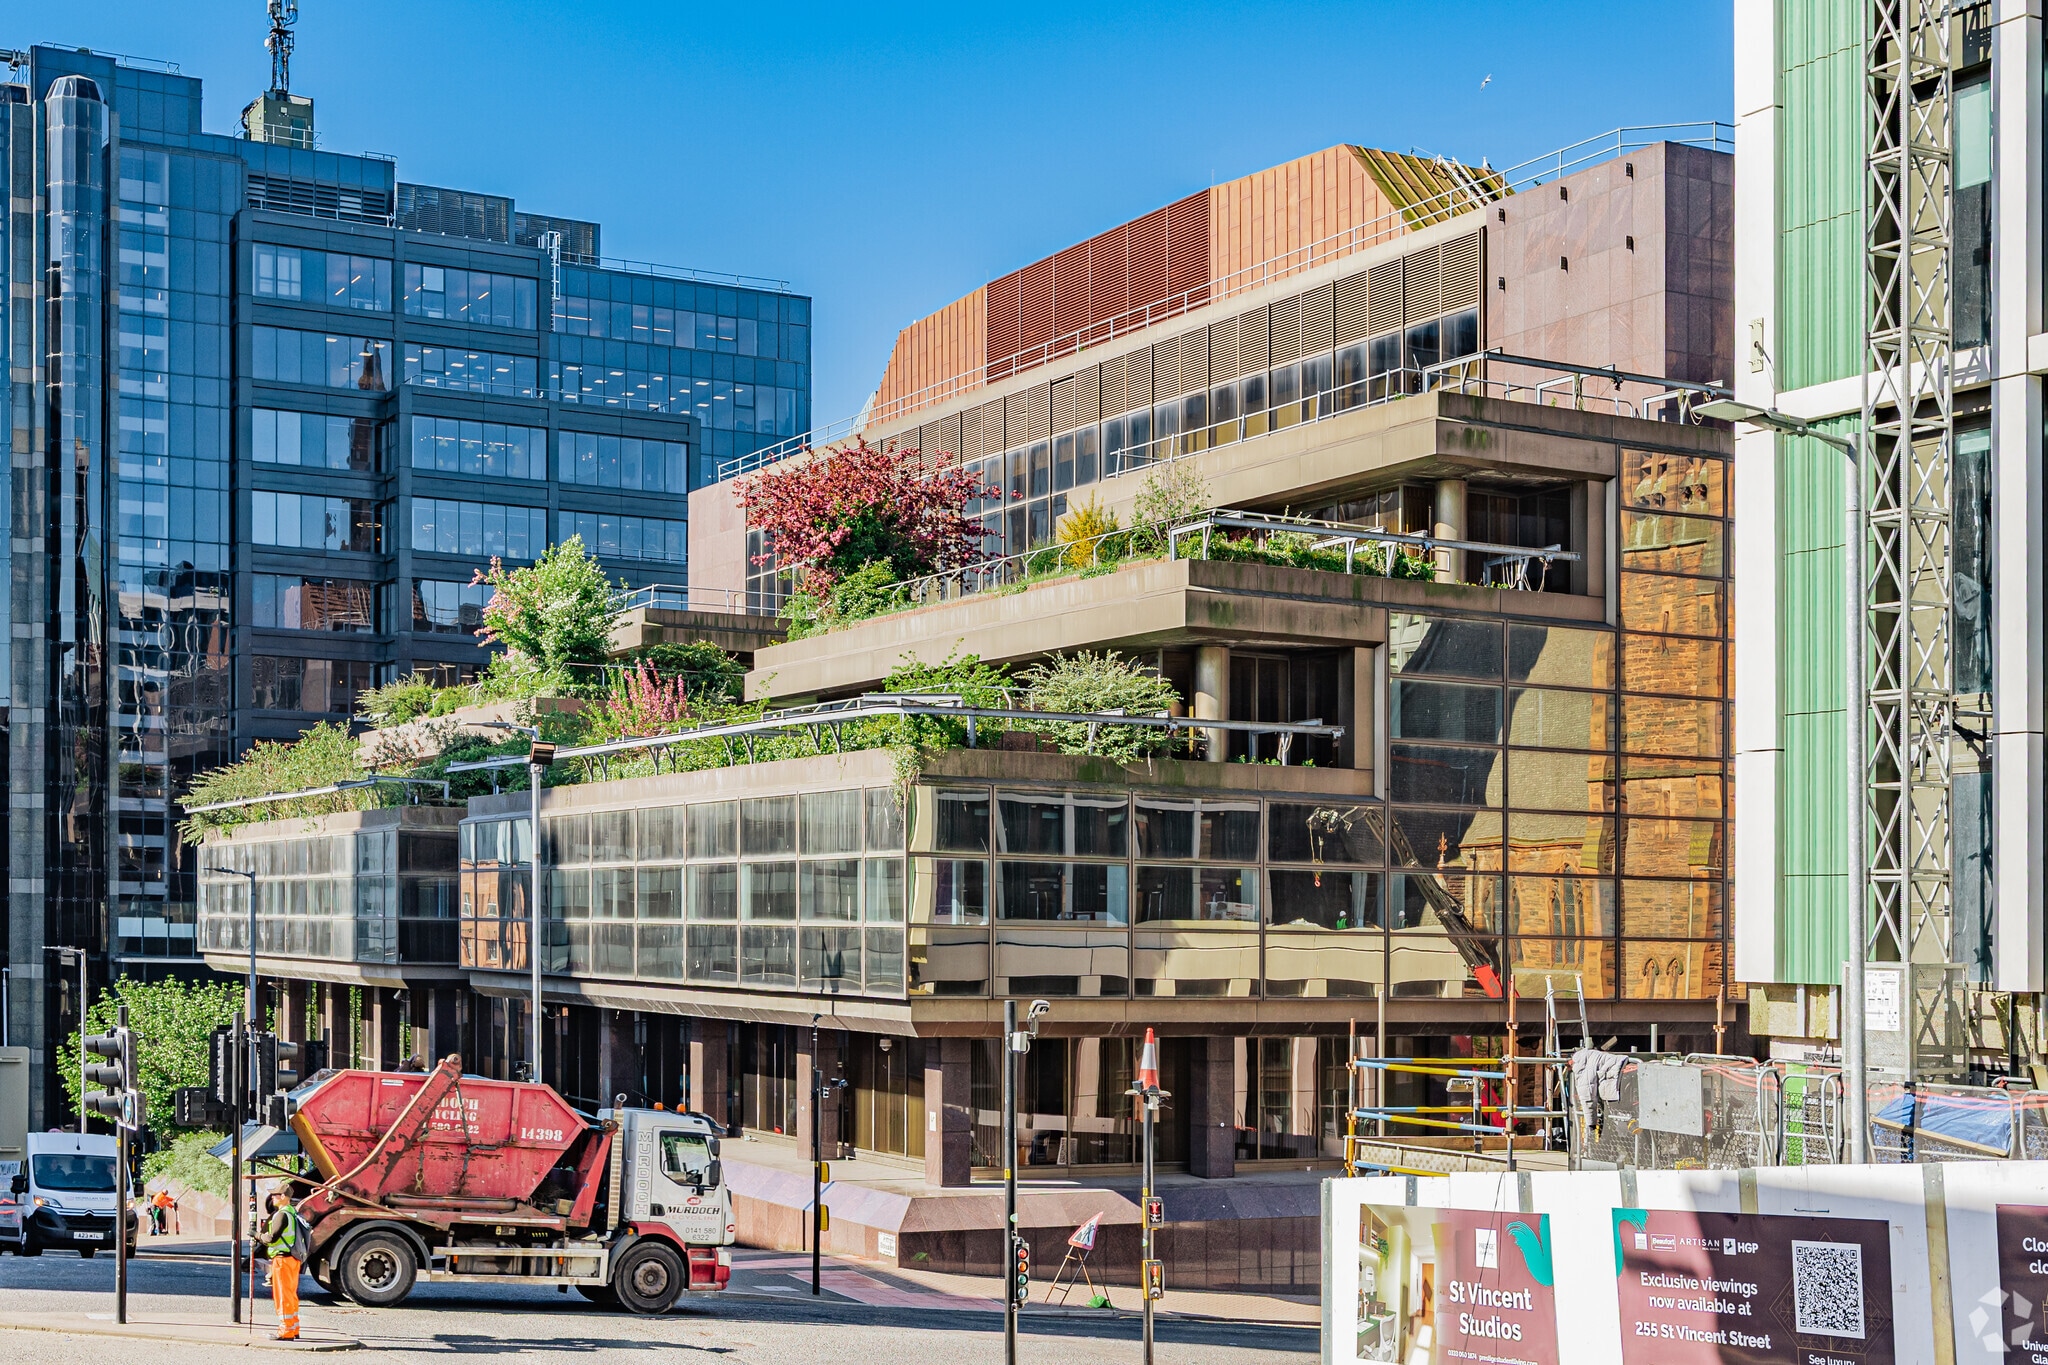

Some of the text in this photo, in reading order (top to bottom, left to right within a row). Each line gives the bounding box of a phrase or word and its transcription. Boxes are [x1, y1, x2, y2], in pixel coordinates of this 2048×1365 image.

[455, 1123, 480, 1134] 622
[520, 1127, 563, 1142] 14398
[635, 1131, 653, 1215] MURDOCH
[666, 1206, 720, 1215] MURDOCH
[704, 1227, 717, 1235] 580
[1679, 1237, 1720, 1247] ARTISAN
[1737, 1242, 1759, 1254] HGP
[1640, 1271, 1758, 1298] Exclusive viewings
[1449, 1280, 1533, 1311] St Vincent
[1648, 1296, 1752, 1316] now available at
[1459, 1312, 1523, 1342] Studios
[1635, 1321, 1772, 1350] 255 St Vincent Street
[1808, 1354, 1826, 1365] See
